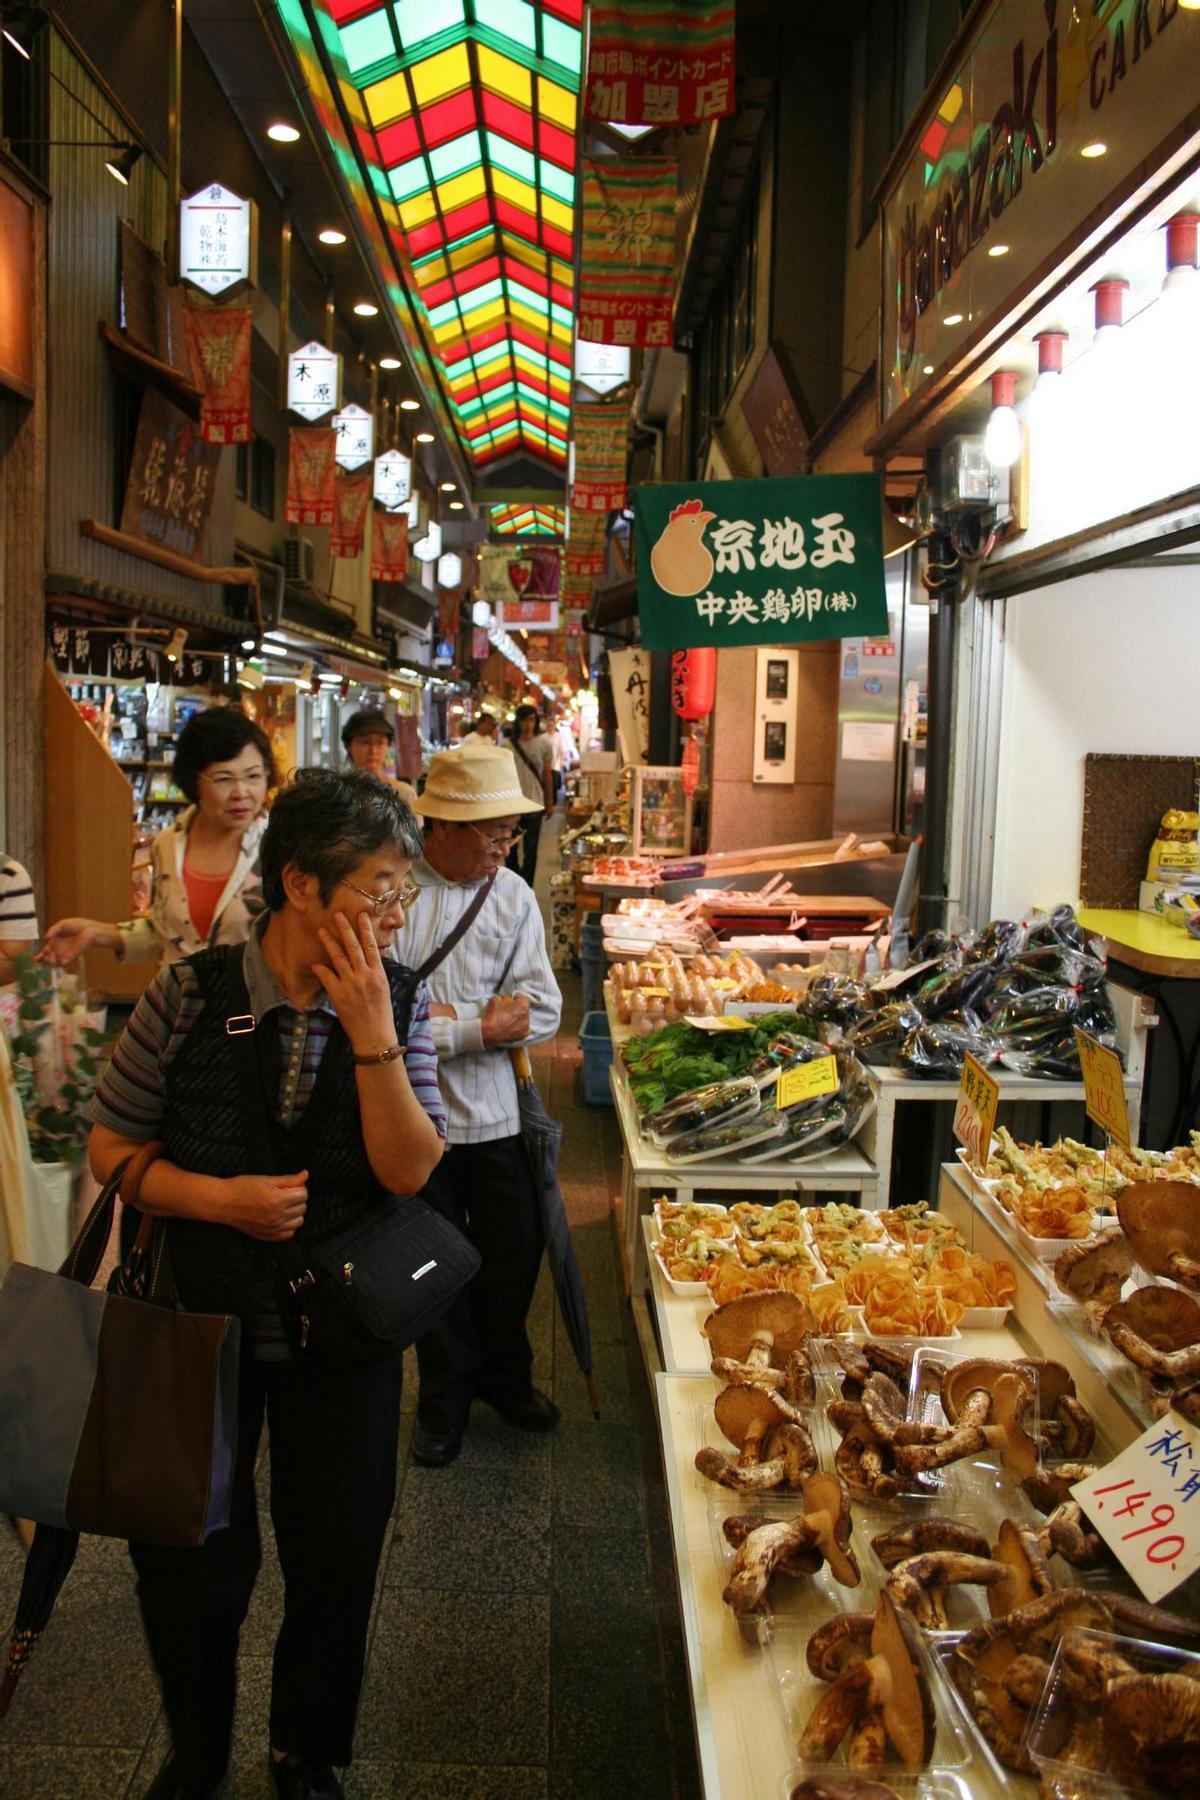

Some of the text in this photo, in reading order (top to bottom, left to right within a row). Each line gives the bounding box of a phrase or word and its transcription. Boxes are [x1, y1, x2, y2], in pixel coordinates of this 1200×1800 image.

[589, 78, 730, 121] 加盟店
[580, 317, 670, 344] 加盟店
[710, 513, 856, 574] 京地玉
[696, 586, 857, 627] 中央鶏卵(株)
